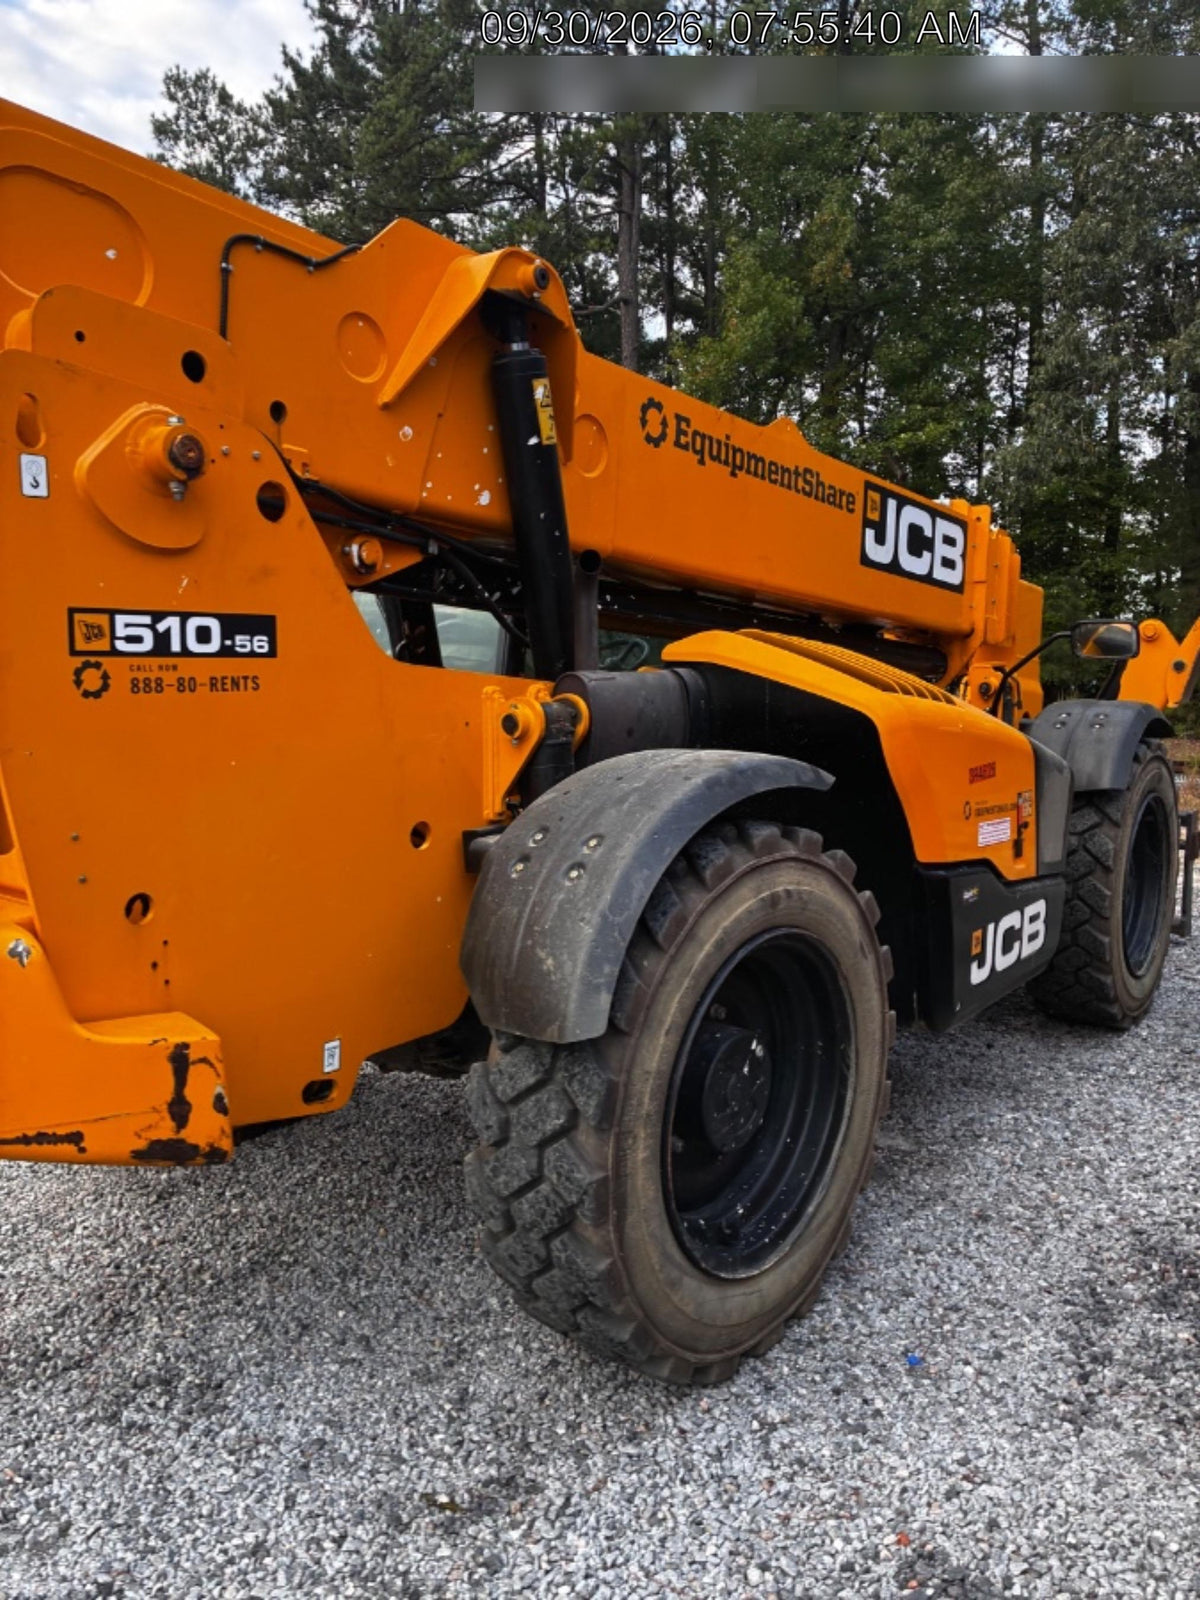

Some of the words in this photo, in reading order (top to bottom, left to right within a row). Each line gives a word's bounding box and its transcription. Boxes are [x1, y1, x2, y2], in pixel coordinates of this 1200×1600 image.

[673, 412, 856, 514] EquipmentShare
[865, 497, 965, 586] JCB
[129, 664, 154, 672] CALL
[158, 664, 178, 672] NOW
[130, 675, 260, 694] 888-80-RENTS
[970, 898, 1047, 985] JCB
